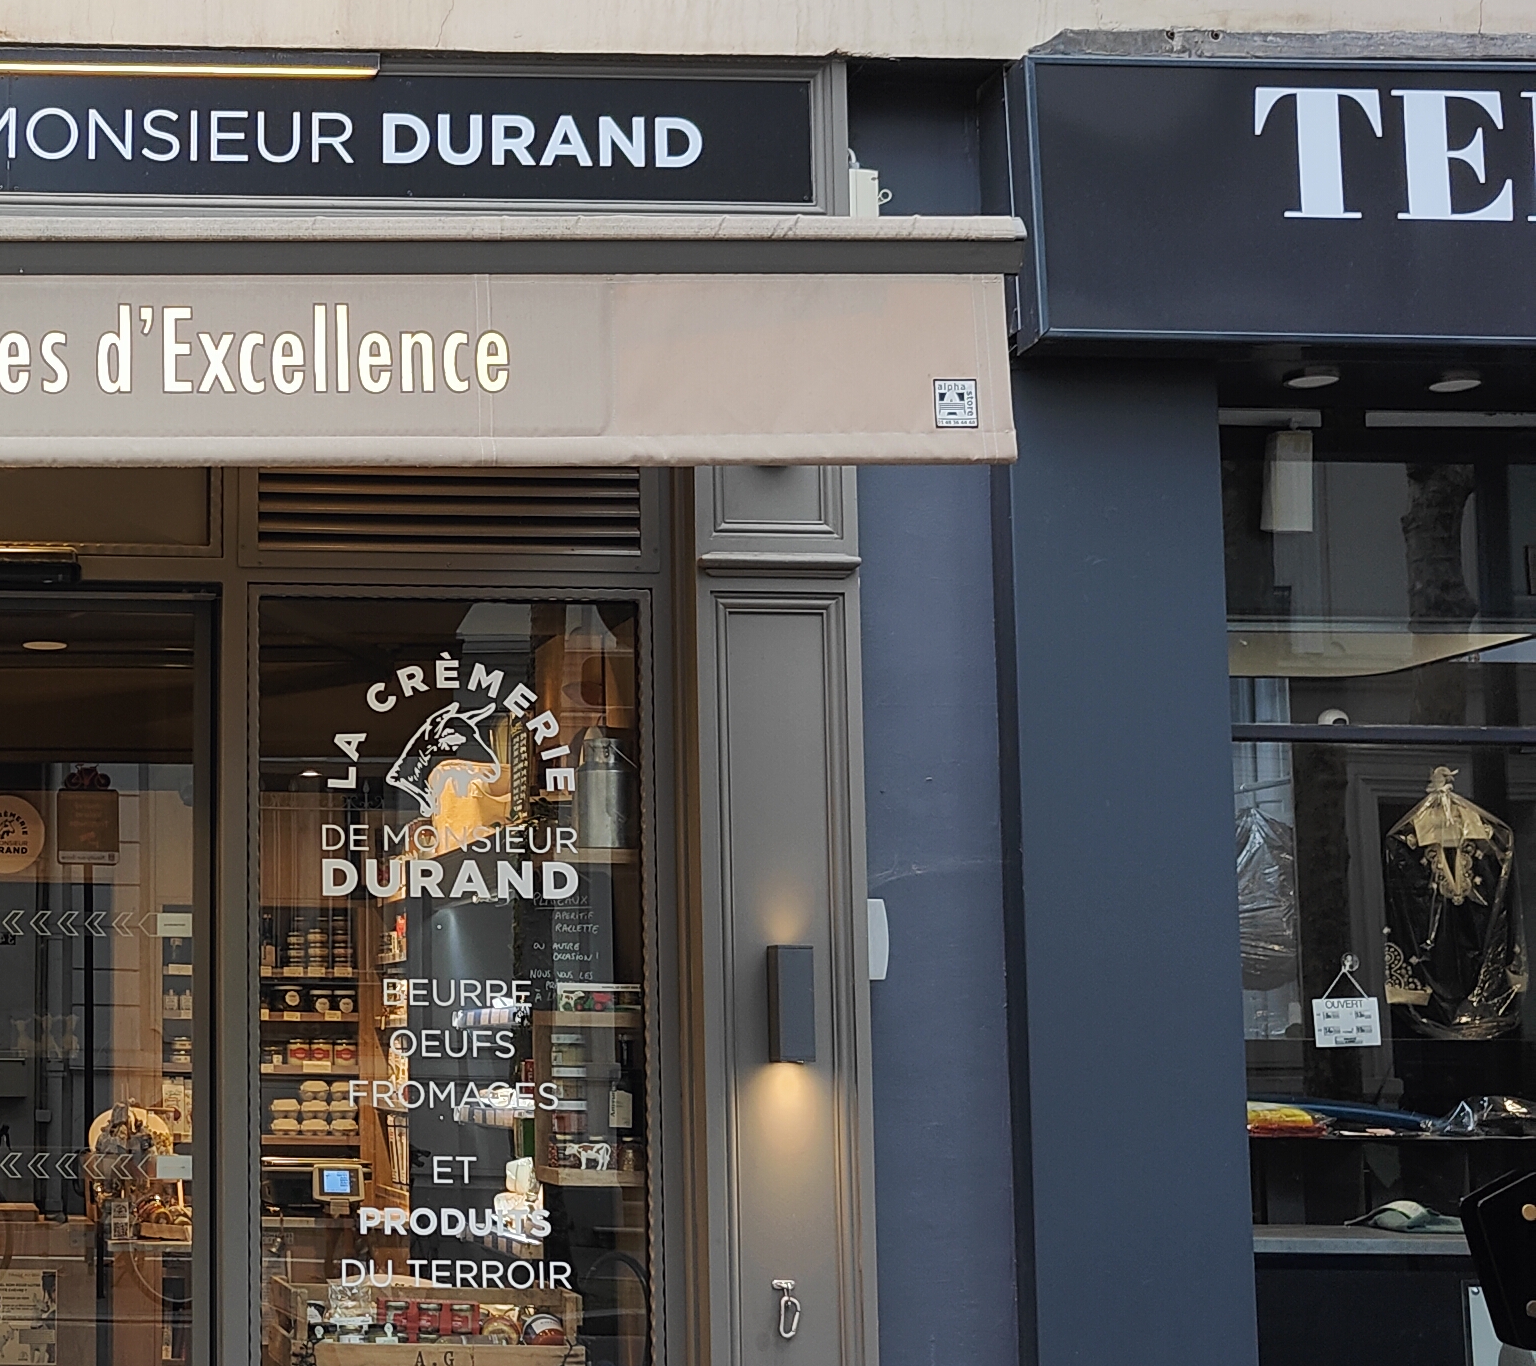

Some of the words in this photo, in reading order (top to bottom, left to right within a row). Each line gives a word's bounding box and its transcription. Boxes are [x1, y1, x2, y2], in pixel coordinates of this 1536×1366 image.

[381, 112, 704, 169] DURAND
[1254, 86, 1536, 222] TE
[96, 302, 511, 395] d'Excellence
[938, 382, 965, 392] alpha
[966, 391, 974, 416] store
[327, 732, 367, 788] LA
[366, 652, 576, 792] CRÈMERIE
[322, 824, 368, 851] DE
[384, 825, 579, 854] MONSIEUR
[322, 858, 579, 900] DURAND
[555, 923, 599, 934] RACLETTE
[552, 942, 580, 951] AUTRE
[552, 952, 592, 962] OCCASION
[530, 969, 551, 979] NOUS
[556, 970, 573, 979] VOUS
[579, 971, 593, 980] LES
[383, 978, 532, 1007] BEURRE
[1325, 1000, 1363, 1009] OUVERT
[389, 1029, 515, 1059] OEUFS
[348, 1080, 559, 1110] FROMAGES
[432, 1156, 477, 1184] ET
[359, 1207, 552, 1237] PRODUITS
[341, 1259, 393, 1288] DU
[407, 1260, 572, 1289] TERROIR
